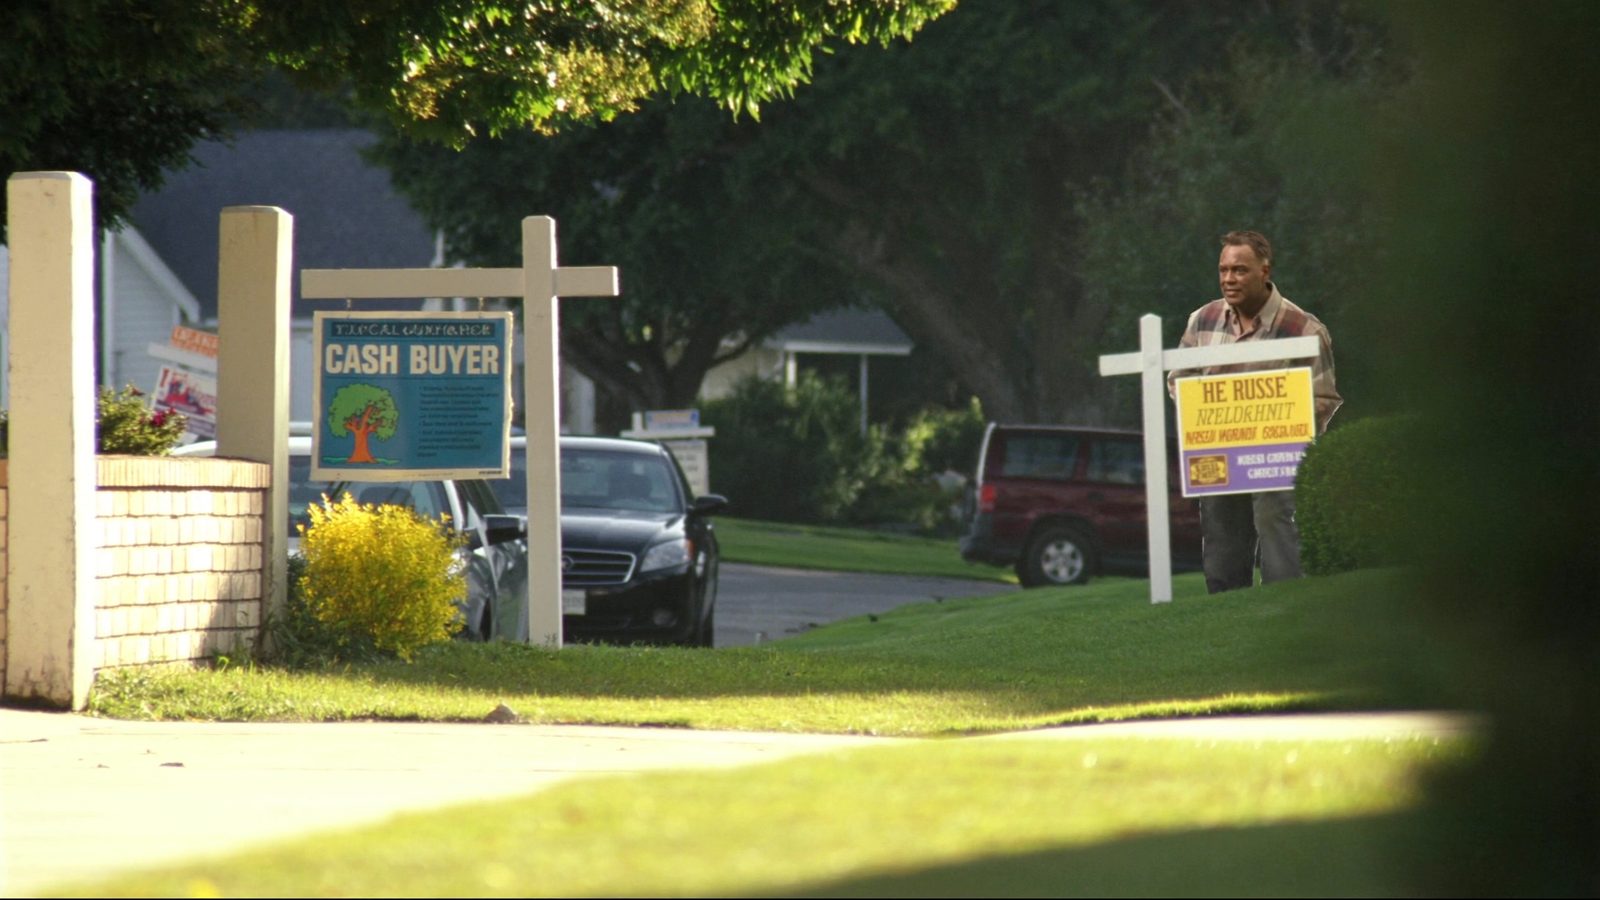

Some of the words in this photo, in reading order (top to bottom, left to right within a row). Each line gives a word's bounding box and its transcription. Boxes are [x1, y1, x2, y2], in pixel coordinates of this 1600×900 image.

[325, 343, 398, 374] CASH
[409, 344, 499, 374] BUYER
[1202, 381, 1228, 404] HE
[1233, 376, 1288, 401] RUSSE
